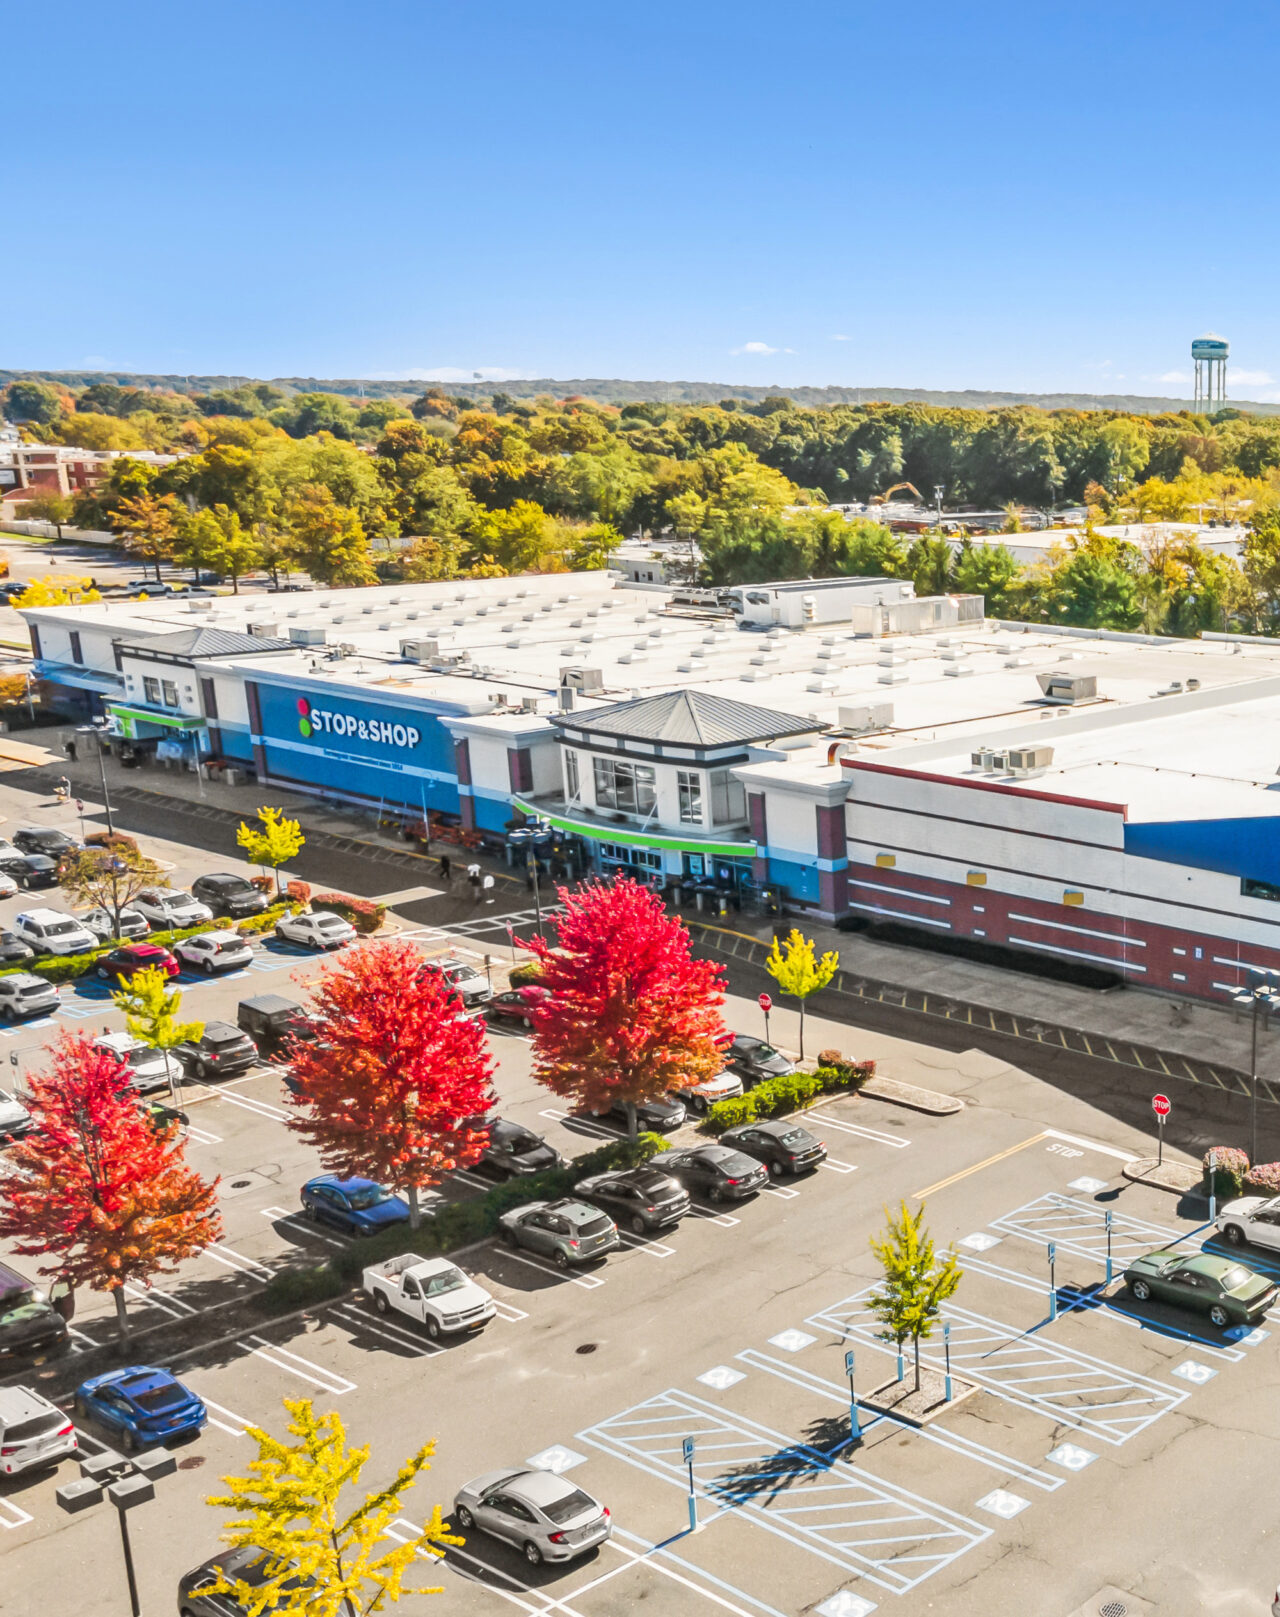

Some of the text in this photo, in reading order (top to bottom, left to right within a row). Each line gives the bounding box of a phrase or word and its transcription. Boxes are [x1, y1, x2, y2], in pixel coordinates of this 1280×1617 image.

[310, 708, 419, 748] STOP&SHOP
[1154, 1099, 1170, 1110] STOP
[1045, 1143, 1084, 1158] STOP
